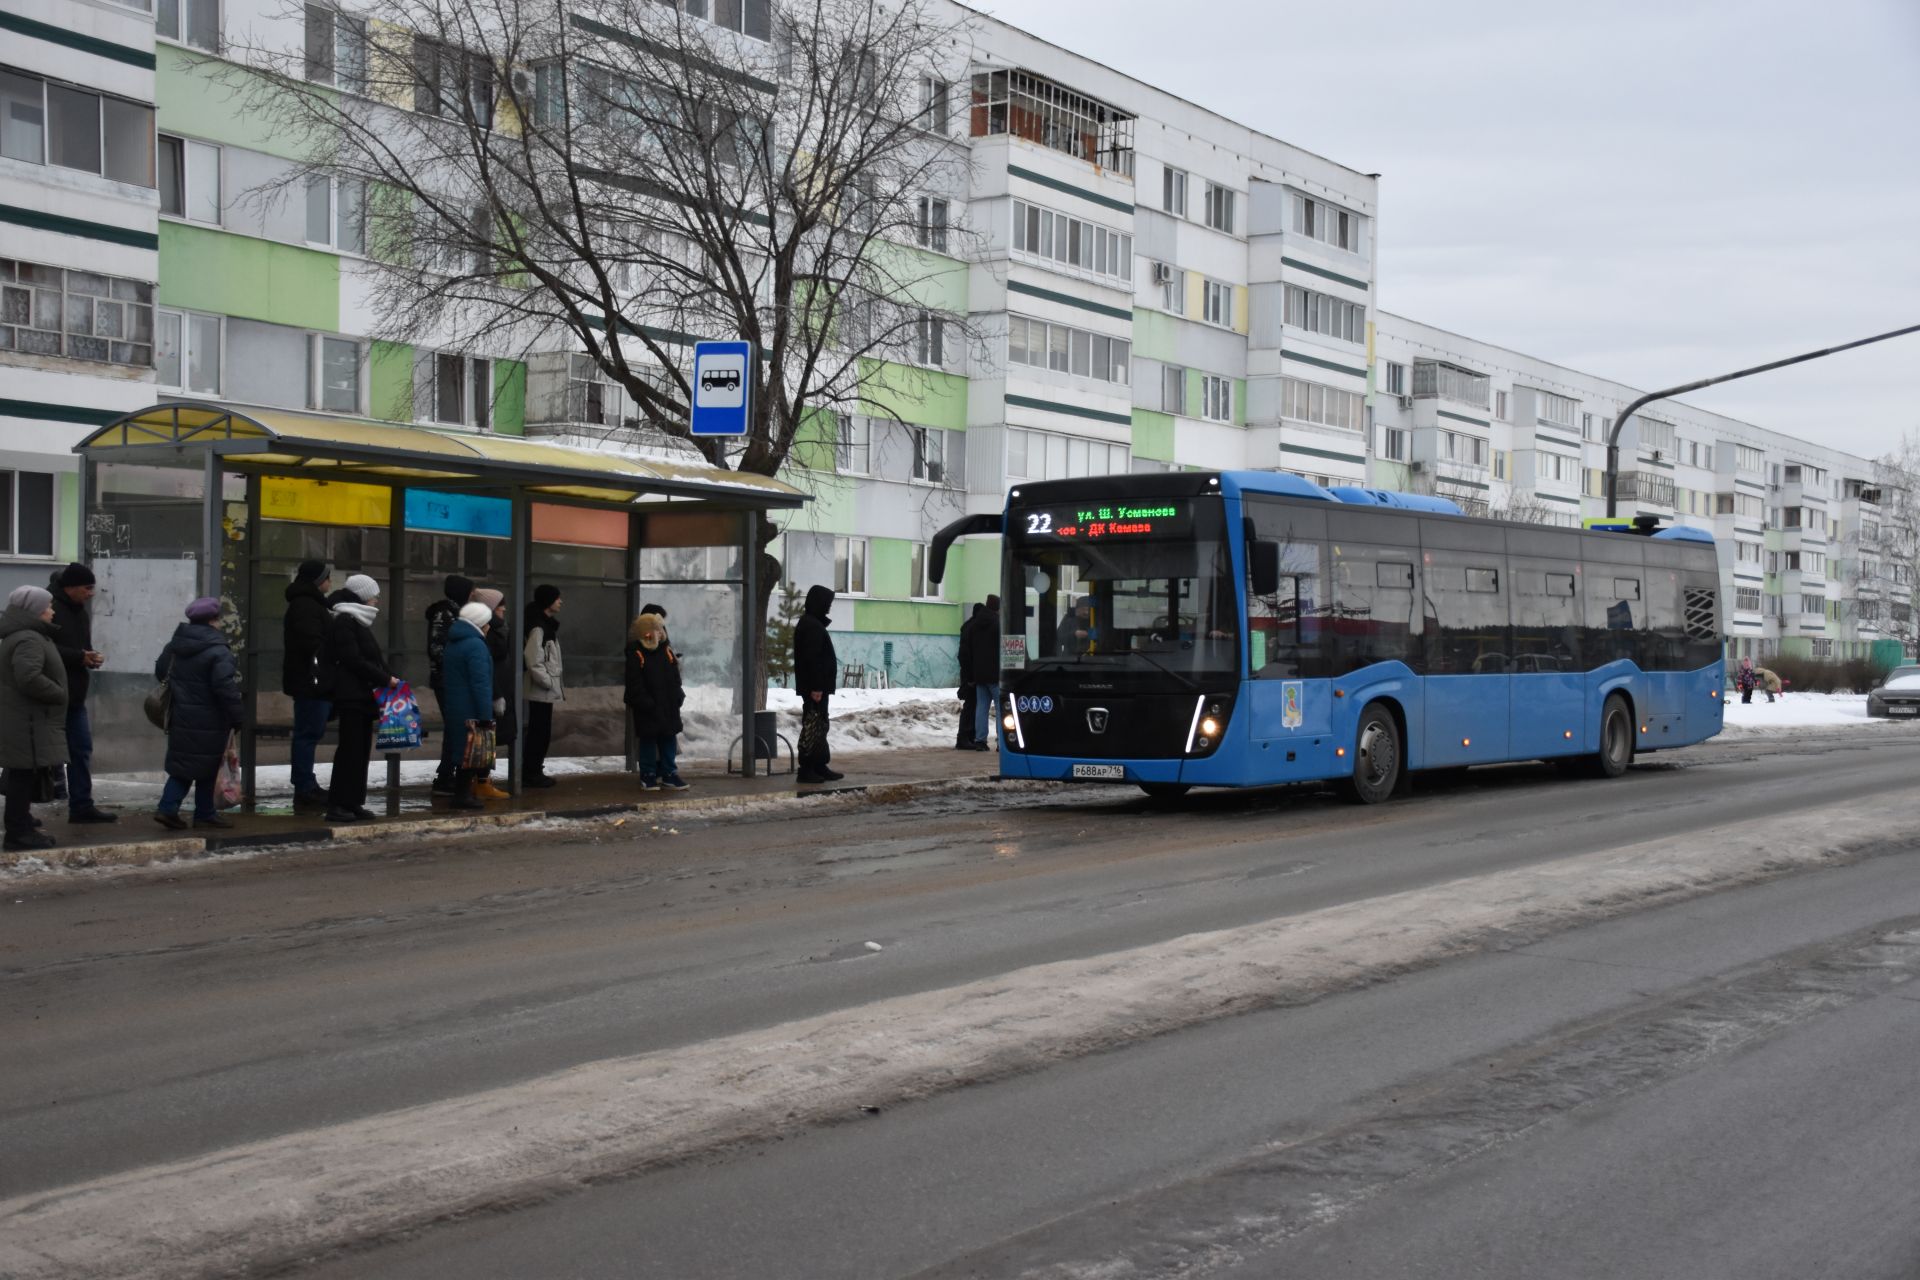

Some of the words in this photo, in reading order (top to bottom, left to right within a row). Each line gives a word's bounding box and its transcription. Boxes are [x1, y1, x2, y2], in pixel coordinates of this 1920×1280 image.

[1077, 511, 1095, 523] ул.
[1098, 508, 1114, 520] Ш.
[1117, 507, 1176, 519] Усманова
[1027, 513, 1052, 534] 22
[1088, 523, 1106, 537] ДК
[1109, 522, 1152, 535] Камаза
